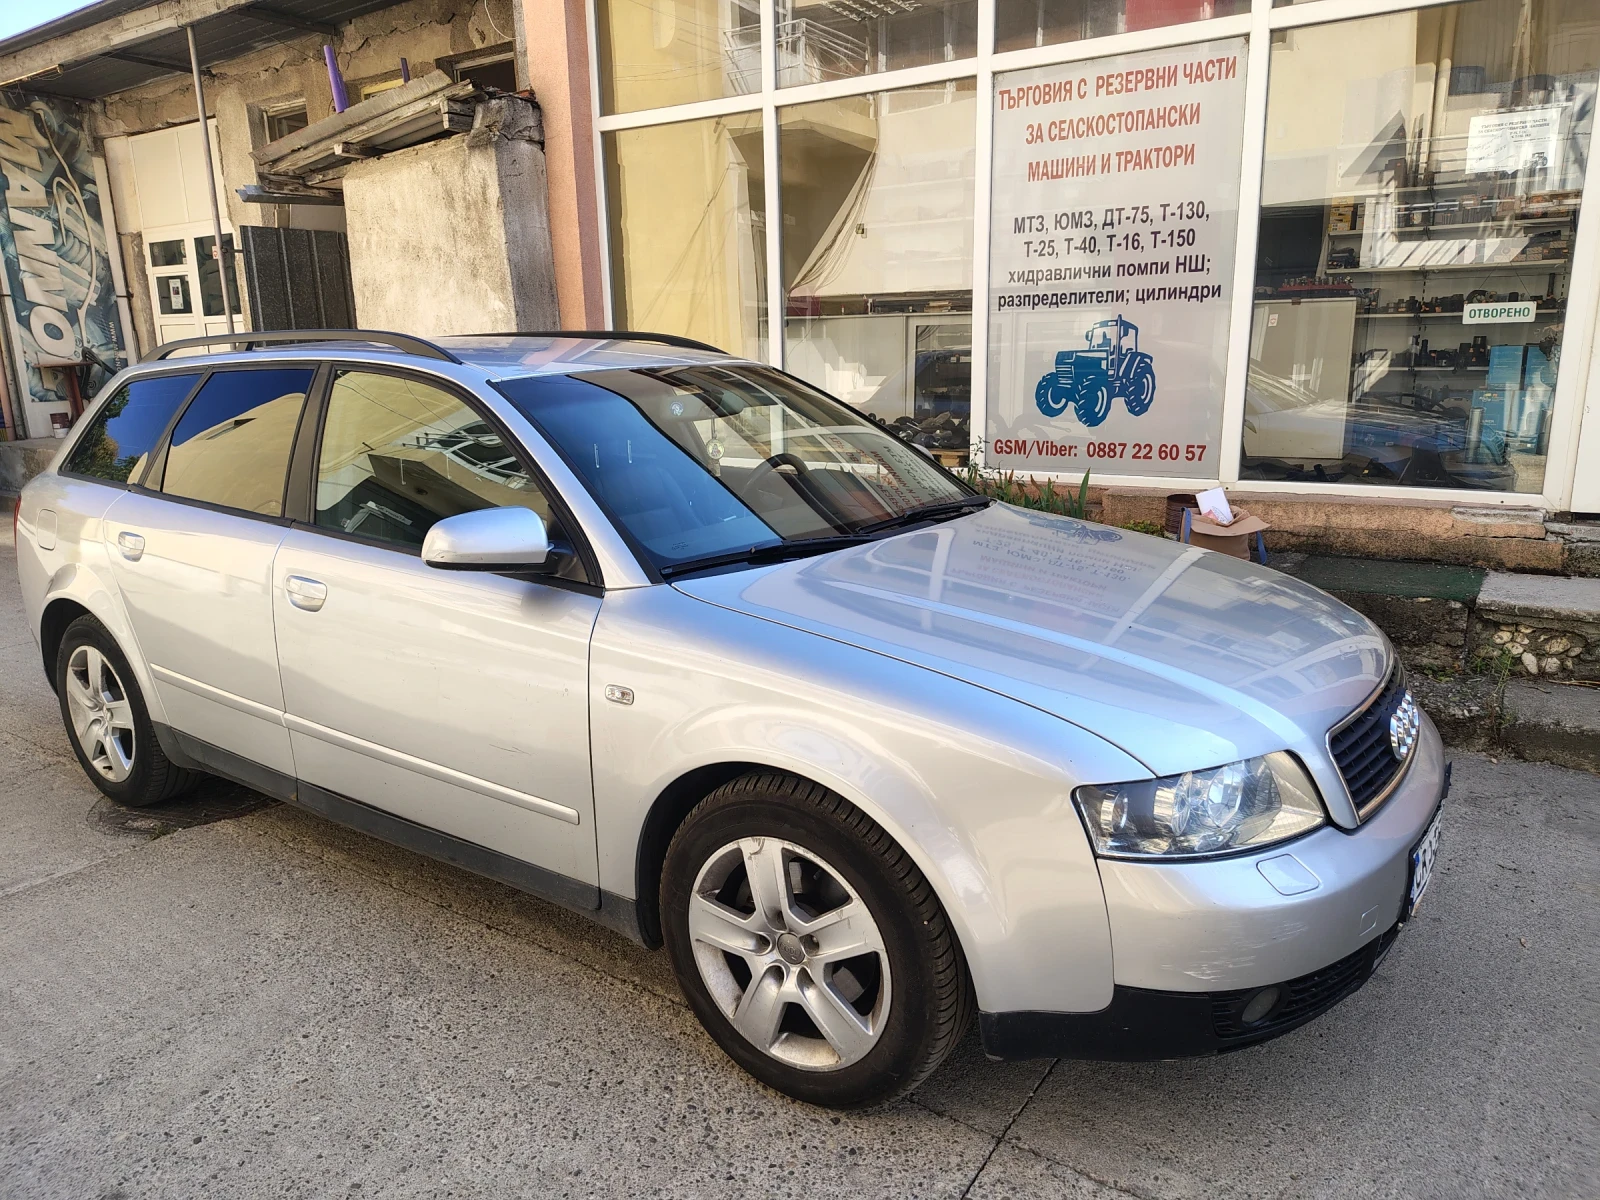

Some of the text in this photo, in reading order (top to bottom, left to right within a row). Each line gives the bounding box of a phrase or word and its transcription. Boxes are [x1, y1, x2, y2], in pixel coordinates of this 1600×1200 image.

[999, 55, 1237, 111] ТЪРГОВИЯ С РЕЗЕРВНИ ЧАСТИ
[1025, 102, 1201, 144] ЗА СЕЛСКОСТОПАНСКИ
[1027, 143, 1195, 182] МАШИНИ И ТРАКТОРИ
[1013, 200, 1210, 235] МТЗ, ЮМЗ, ДТ-75, Т-130,
[1024, 228, 1196, 259] Т-25, Т-40, Т-16, Т-150
[1008, 253, 1211, 286] хидравлични помпи НШ;
[998, 283, 1222, 312] разпределители; цилиндри
[1469, 306, 1530, 319] ОТВОРЕНО
[994, 439, 1207, 462] GSM/Viber: 0887 22 60 57
